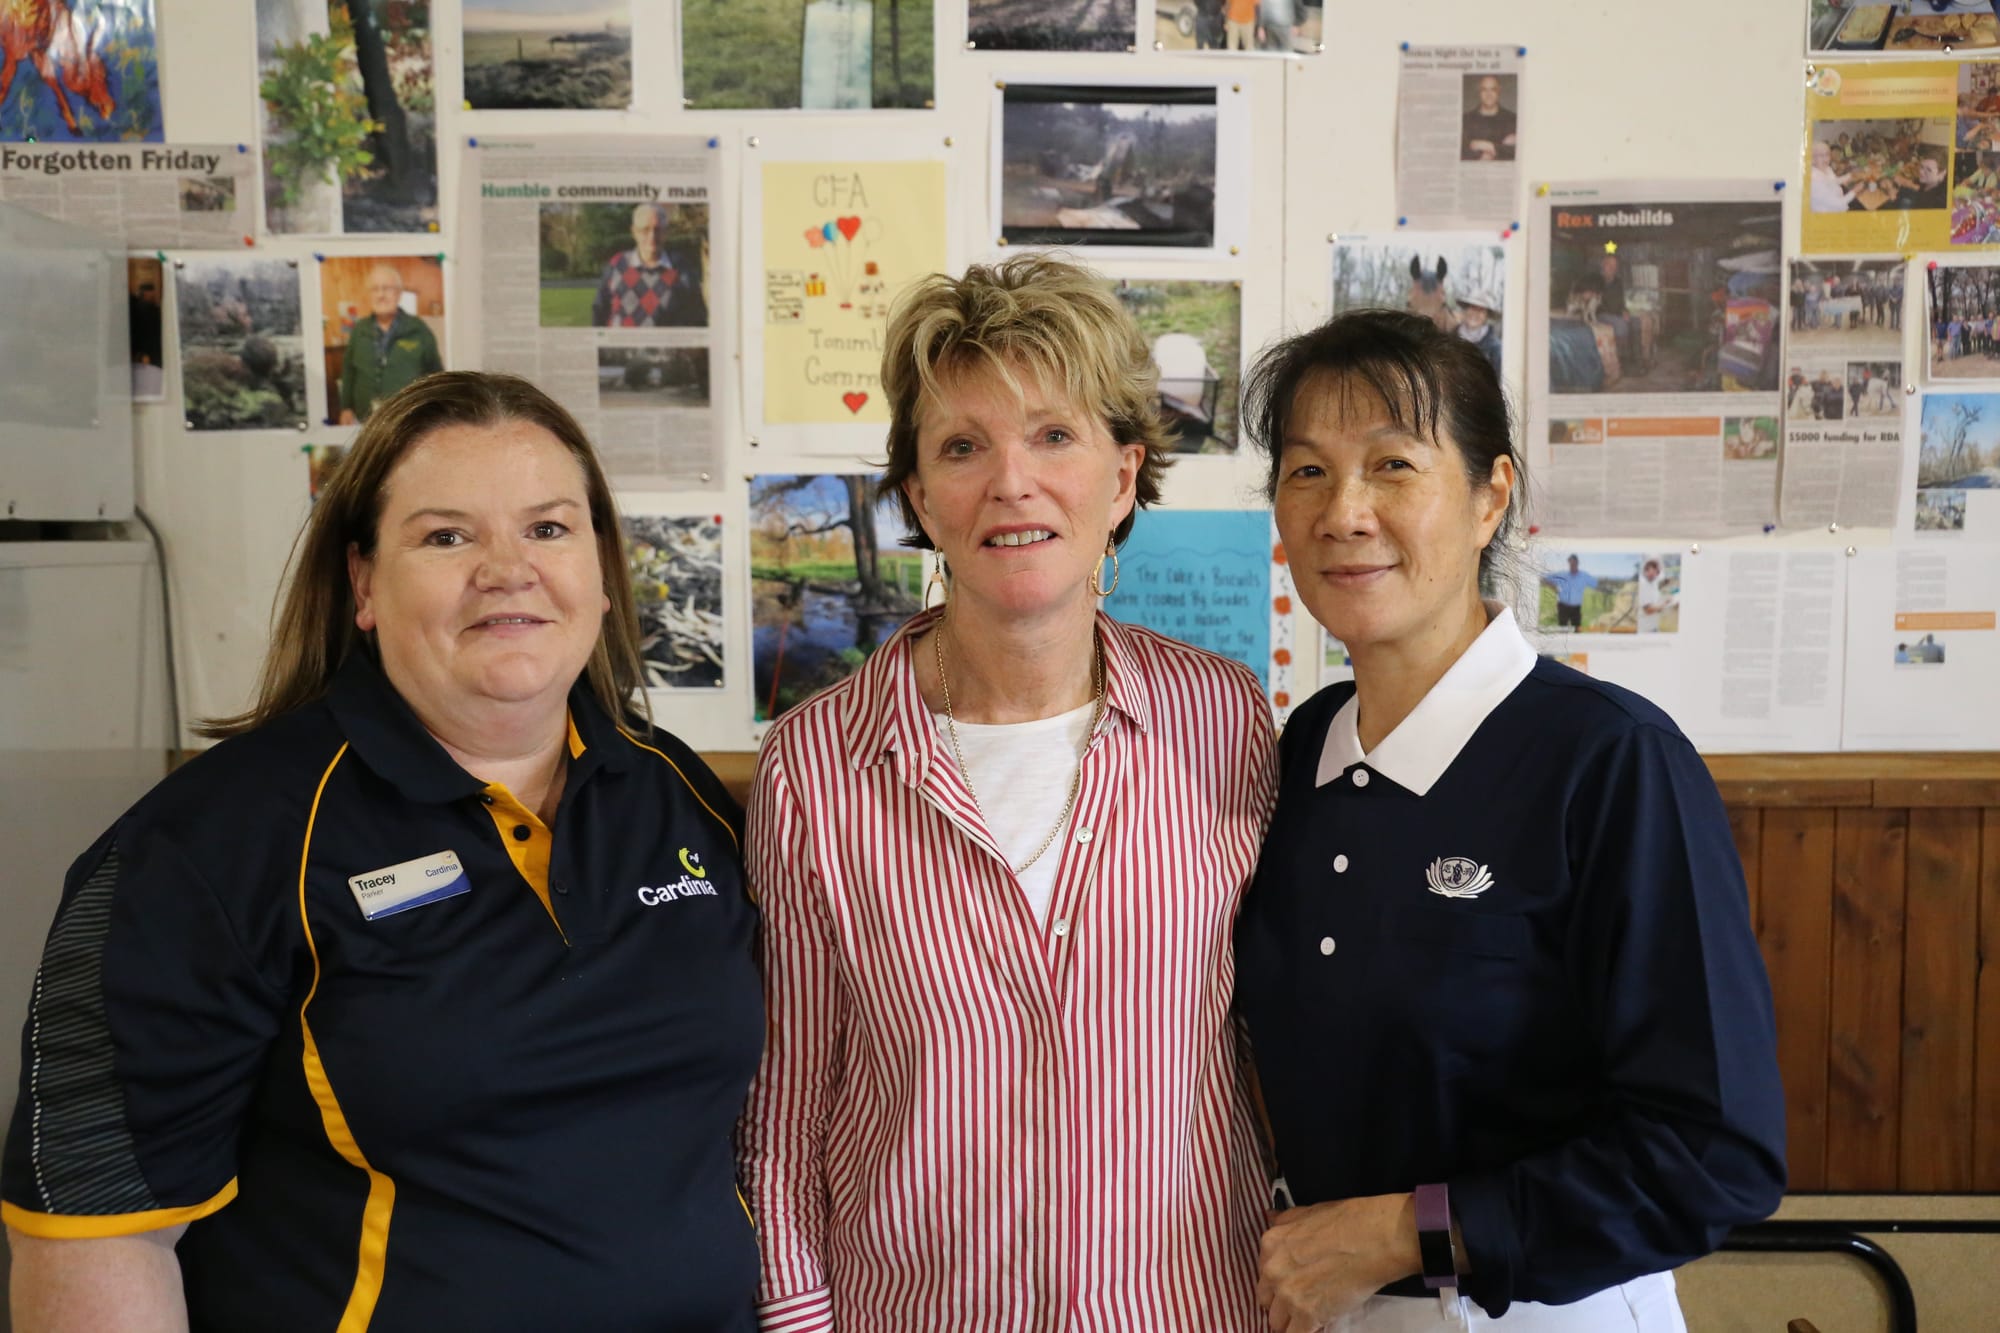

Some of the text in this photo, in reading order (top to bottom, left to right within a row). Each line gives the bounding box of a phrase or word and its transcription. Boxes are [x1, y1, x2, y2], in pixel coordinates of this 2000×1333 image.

[1, 149, 220, 175] Forgotten Friday
[481, 183, 707, 200] Humble community man
[812, 172, 869, 209] CFA
[1557, 209, 1674, 228] Rex rebuilds
[804, 354, 881, 386] Comm
[355, 863, 458, 892] Tracey Cardinia
[638, 874, 719, 906] Cardinia
[361, 888, 384, 899] Parker
